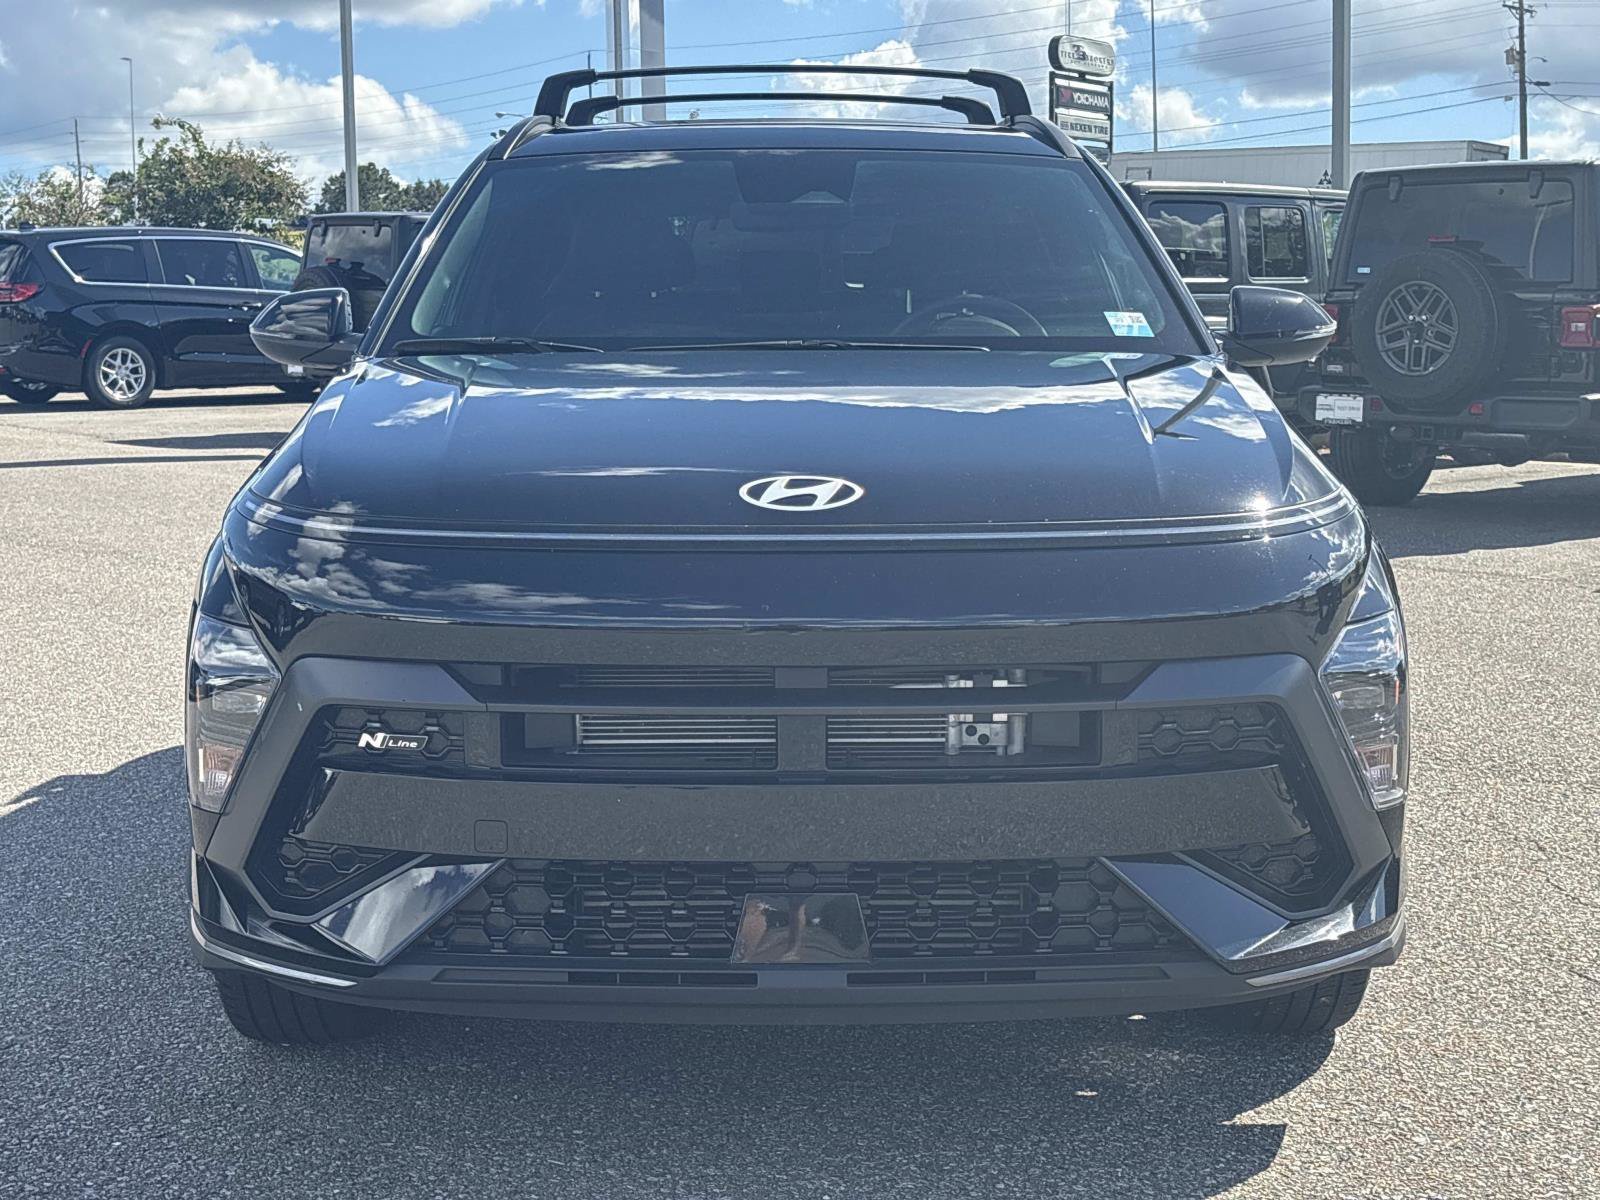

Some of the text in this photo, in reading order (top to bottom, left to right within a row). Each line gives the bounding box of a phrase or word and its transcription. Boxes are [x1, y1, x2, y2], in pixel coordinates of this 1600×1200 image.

[1072, 92, 1110, 108] YOKOHAMA
[1070, 122, 1109, 136] NEXEN TIRE
